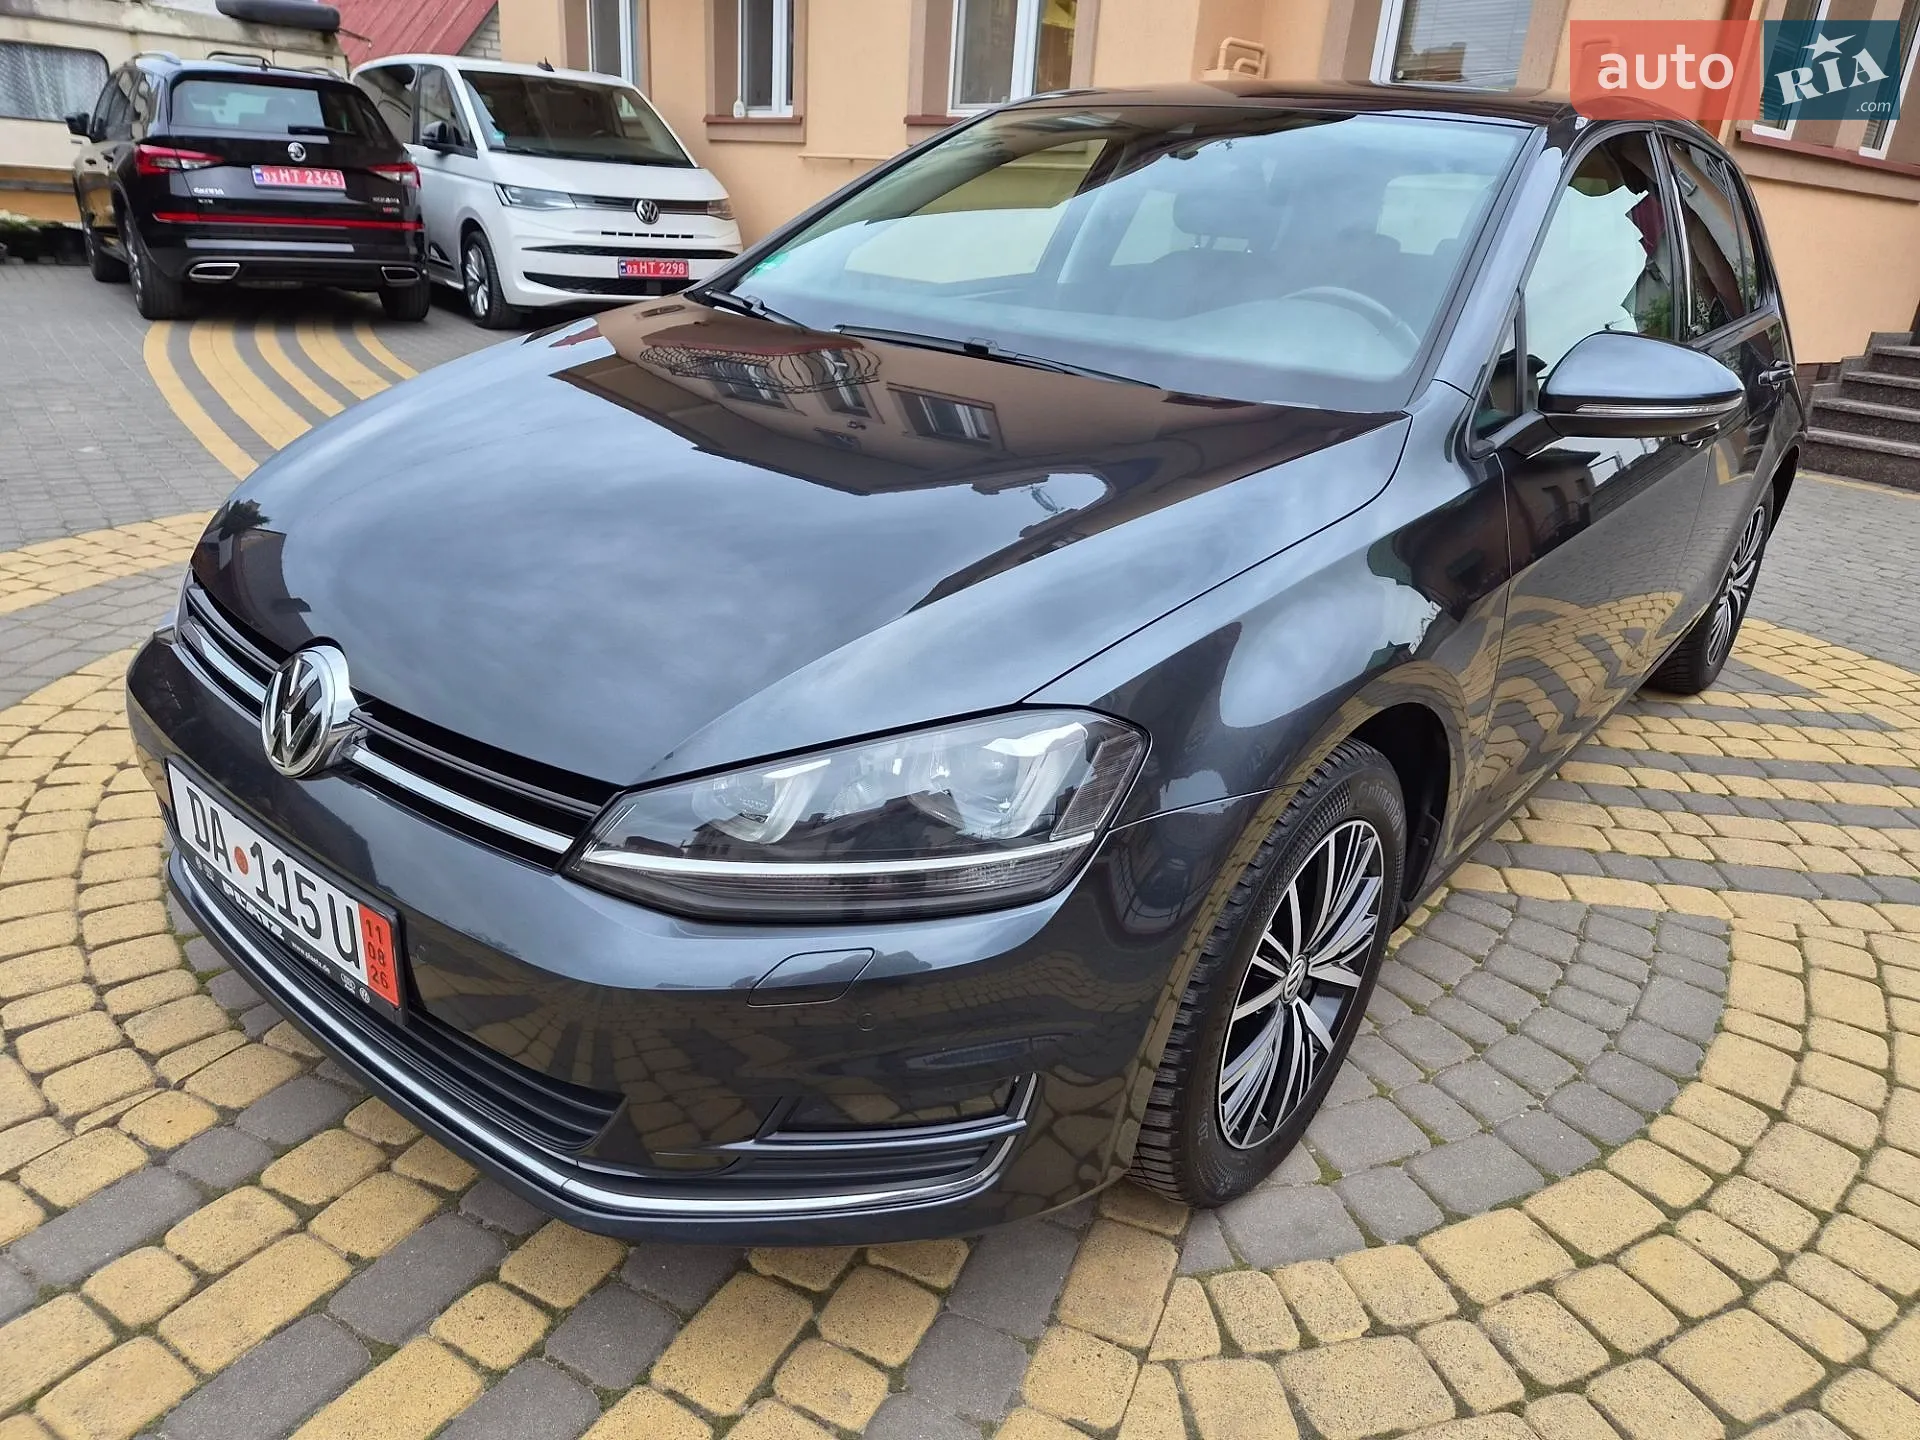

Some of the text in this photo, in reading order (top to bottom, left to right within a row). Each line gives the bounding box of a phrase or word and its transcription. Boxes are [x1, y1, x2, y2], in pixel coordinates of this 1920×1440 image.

[279, 169, 300, 184] HT
[304, 170, 340, 186] 2343
[626, 260, 685, 274] 03 HT 2298
[186, 786, 232, 874] DA
[365, 918, 383, 945] 11
[367, 941, 386, 967] 08
[370, 964, 389, 990] 26
